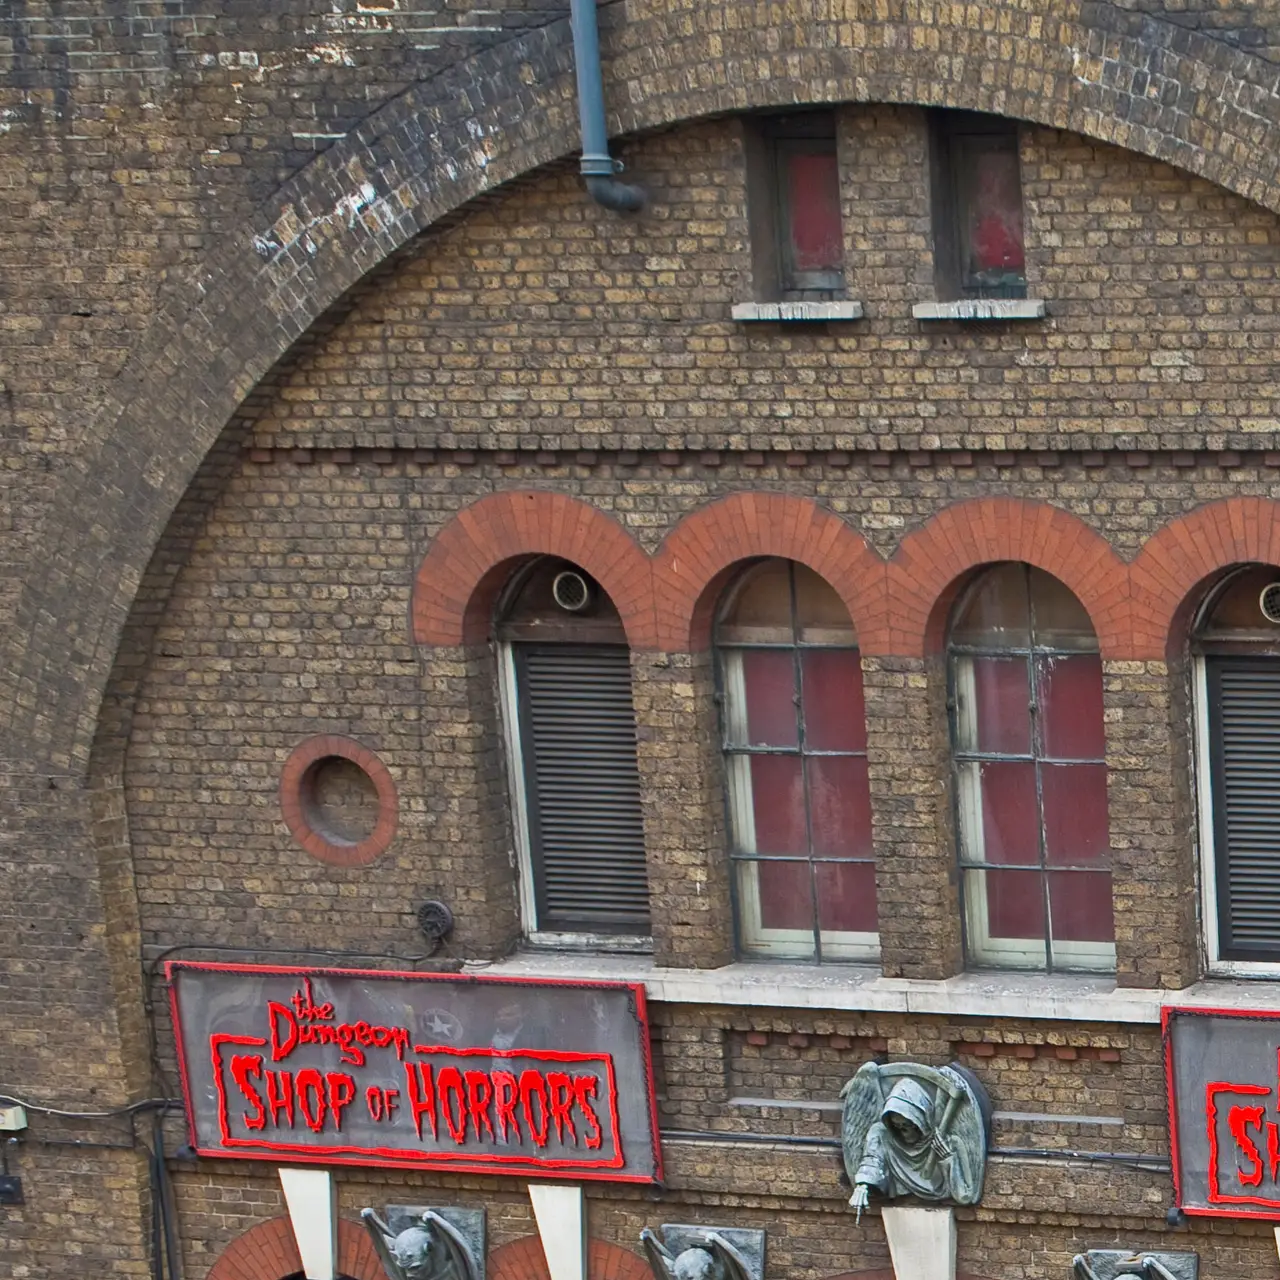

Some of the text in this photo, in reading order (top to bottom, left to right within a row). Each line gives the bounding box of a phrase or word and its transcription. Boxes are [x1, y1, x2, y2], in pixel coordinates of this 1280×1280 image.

[291, 976, 334, 1020] the
[268, 1001, 410, 1066] Dungeon
[230, 1054, 603, 1150] SHOP OF HORRORS
